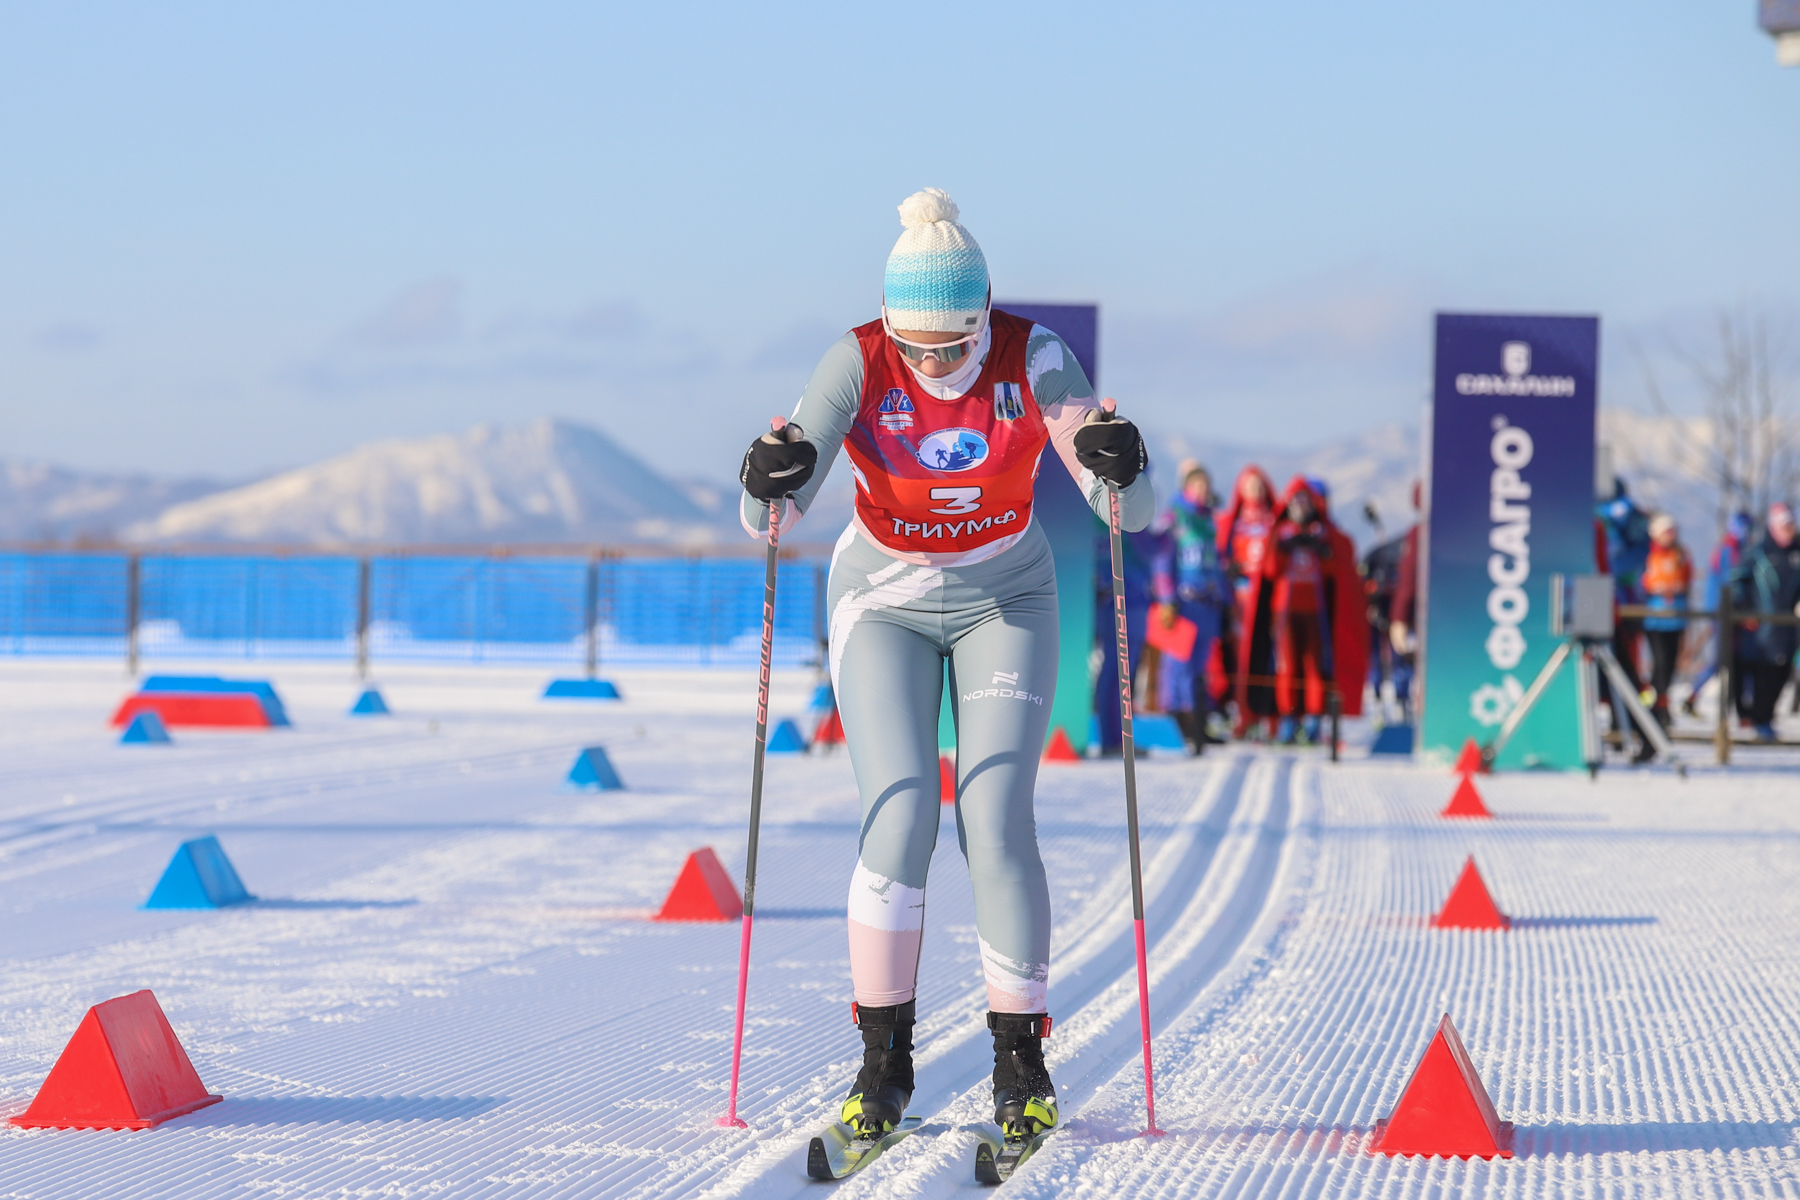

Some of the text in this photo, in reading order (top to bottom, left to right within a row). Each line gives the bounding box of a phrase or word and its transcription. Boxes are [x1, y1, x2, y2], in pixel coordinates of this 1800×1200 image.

[928, 485, 983, 516] 3
[891, 509, 1018, 539] ТРИУМФ
[1485, 426, 1533, 670] ФОСАГРО
[962, 688, 1043, 706] NORDSKI
